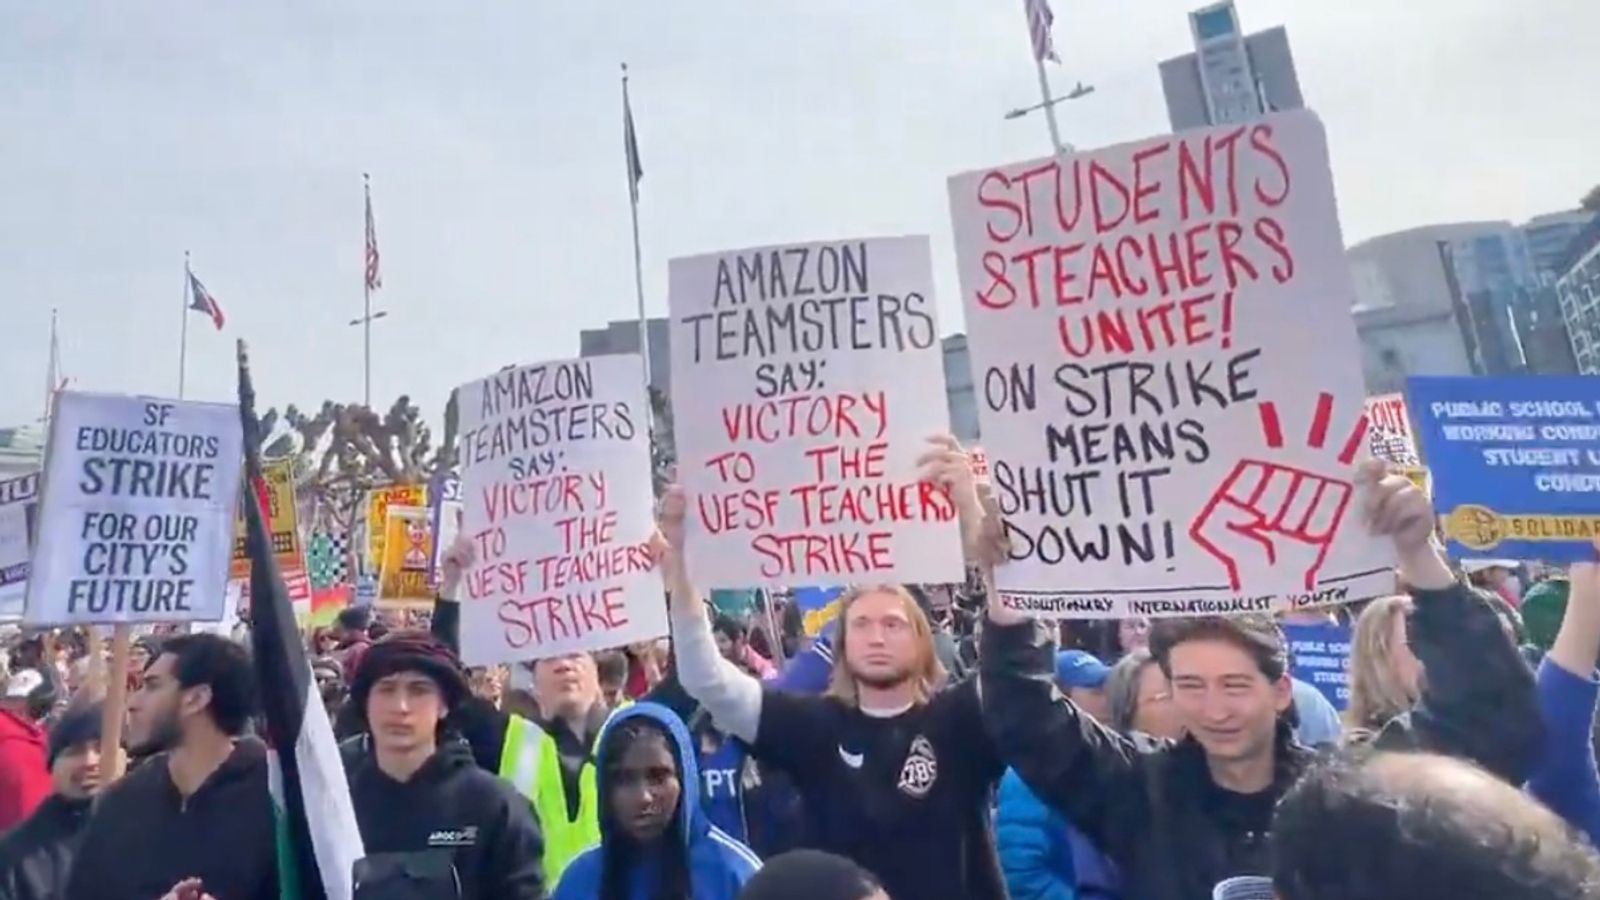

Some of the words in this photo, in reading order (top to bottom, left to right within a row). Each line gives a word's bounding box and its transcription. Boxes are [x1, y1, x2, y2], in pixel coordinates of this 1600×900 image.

[977, 124, 1290, 243] STUDENTS
[713, 243, 868, 307] AMAZON
[682, 292, 935, 363] TEAMSTERS
[1058, 292, 1234, 358] UNITE!
[482, 362, 594, 421] AMAZON
[756, 360, 827, 399] SAY:
[985, 363, 1035, 412] ON
[1054, 348, 1261, 418] STRIKE
[143, 403, 175, 426] SF
[723, 391, 887, 443] VICTORY
[1431, 400, 1502, 418] PUBLIC
[1508, 400, 1593, 418] SCHOOL
[76, 427, 219, 459] EDUCATORS
[463, 402, 636, 468] TEAMSTERS
[1045, 418, 1211, 465] MEANS
[1482, 448, 1579, 466] STUDENT
[80, 458, 214, 499] STRIKE
[509, 451, 568, 481] SAY:
[705, 452, 755, 484] TO
[805, 443, 888, 482] THE
[483, 471, 609, 524] VICTORY
[698, 489, 780, 534] UESF
[790, 480, 957, 527] TEACHERS
[994, 460, 1100, 518] SHUT
[1119, 467, 1171, 519] IT
[81, 512, 138, 541] FOR
[144, 514, 197, 542] OUR
[475, 527, 506, 563] TO
[554, 511, 618, 554] THE
[1001, 520, 1176, 573] DOWN!
[83, 543, 189, 576] CITY'S
[467, 560, 528, 599] UESF
[536, 542, 654, 592] TEACHERS
[752, 532, 894, 578] STRIKE
[67, 579, 195, 614] FUTURE
[498, 587, 629, 649] STRIKE
[1001, 595, 1114, 613] REVOLUTIONARY
[1128, 594, 1277, 615] INTERNATIONALIST
[1286, 586, 1350, 609] YOUTH
[702, 769, 737, 797] PT
